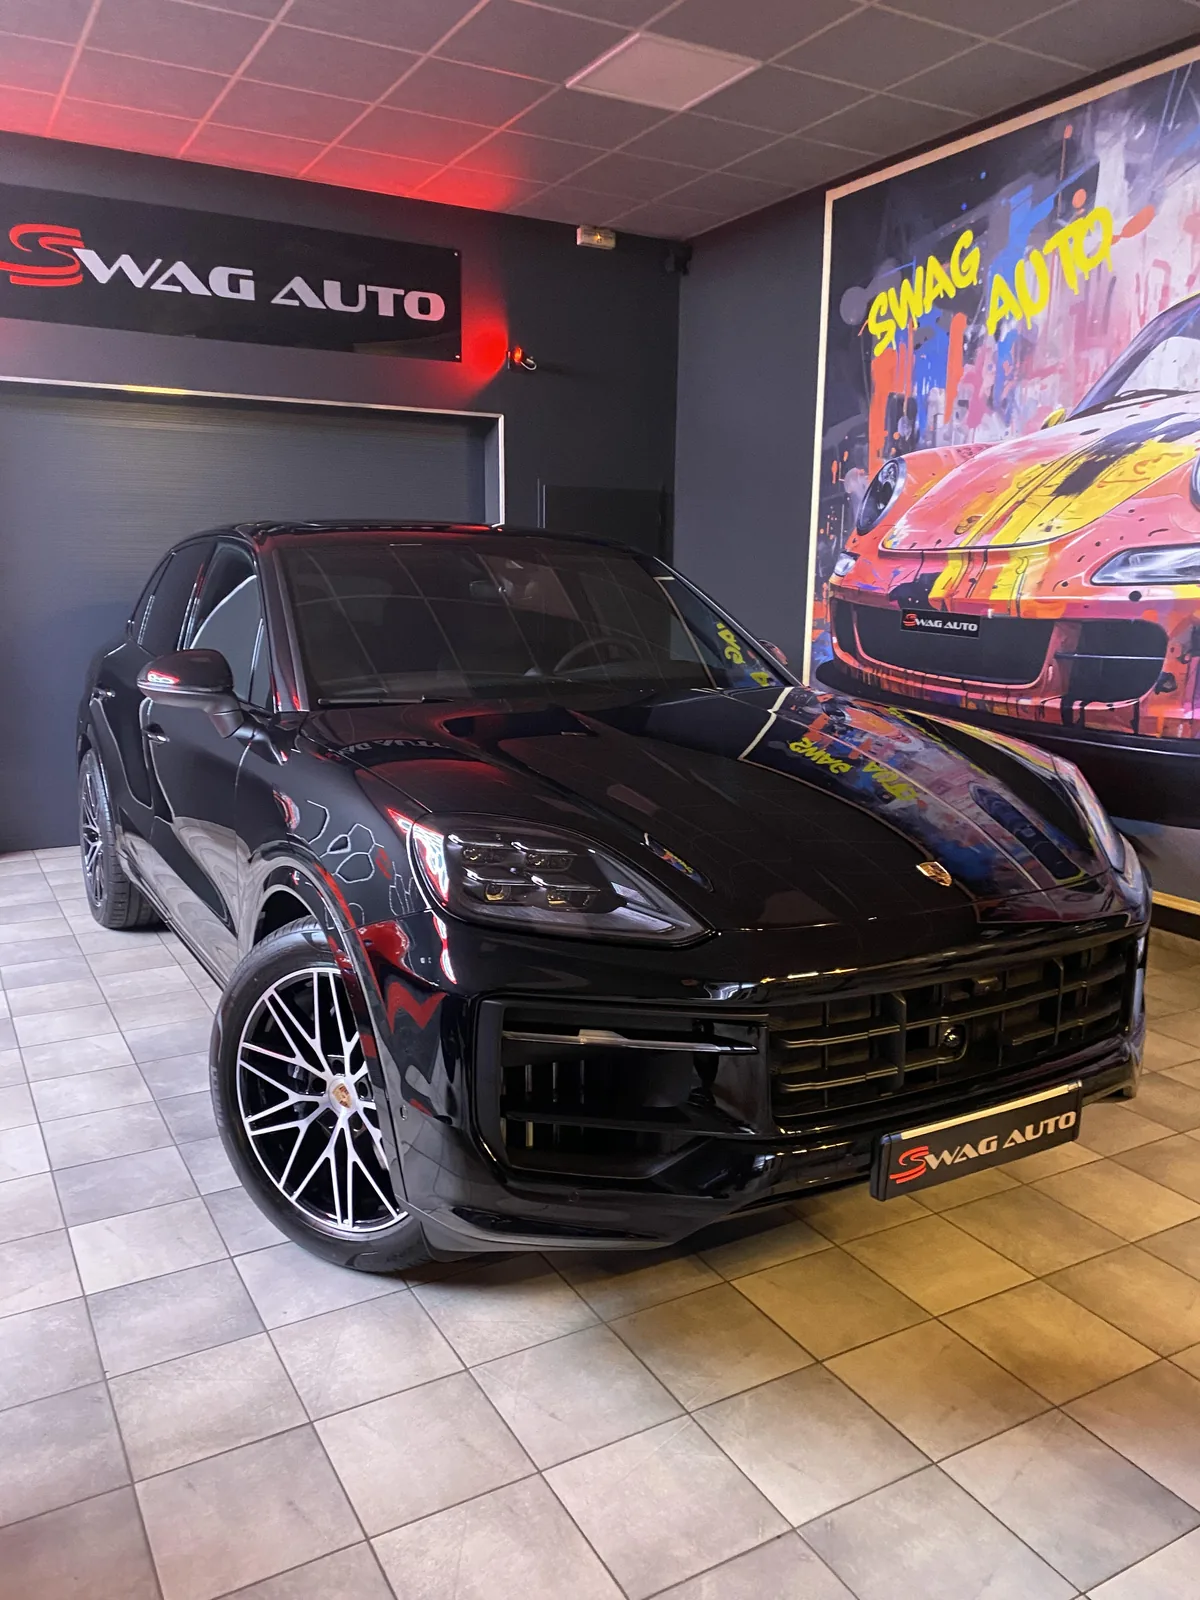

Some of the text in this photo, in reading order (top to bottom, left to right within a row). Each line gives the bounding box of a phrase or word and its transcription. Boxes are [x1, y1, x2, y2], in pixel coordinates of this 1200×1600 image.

[0, 223, 446, 322] SWAG AUTO
[867, 206, 1114, 357] SWAG AUTO
[902, 613, 978, 631] SWAG AUTO
[889, 1111, 1077, 1184] SWAG AUTO
